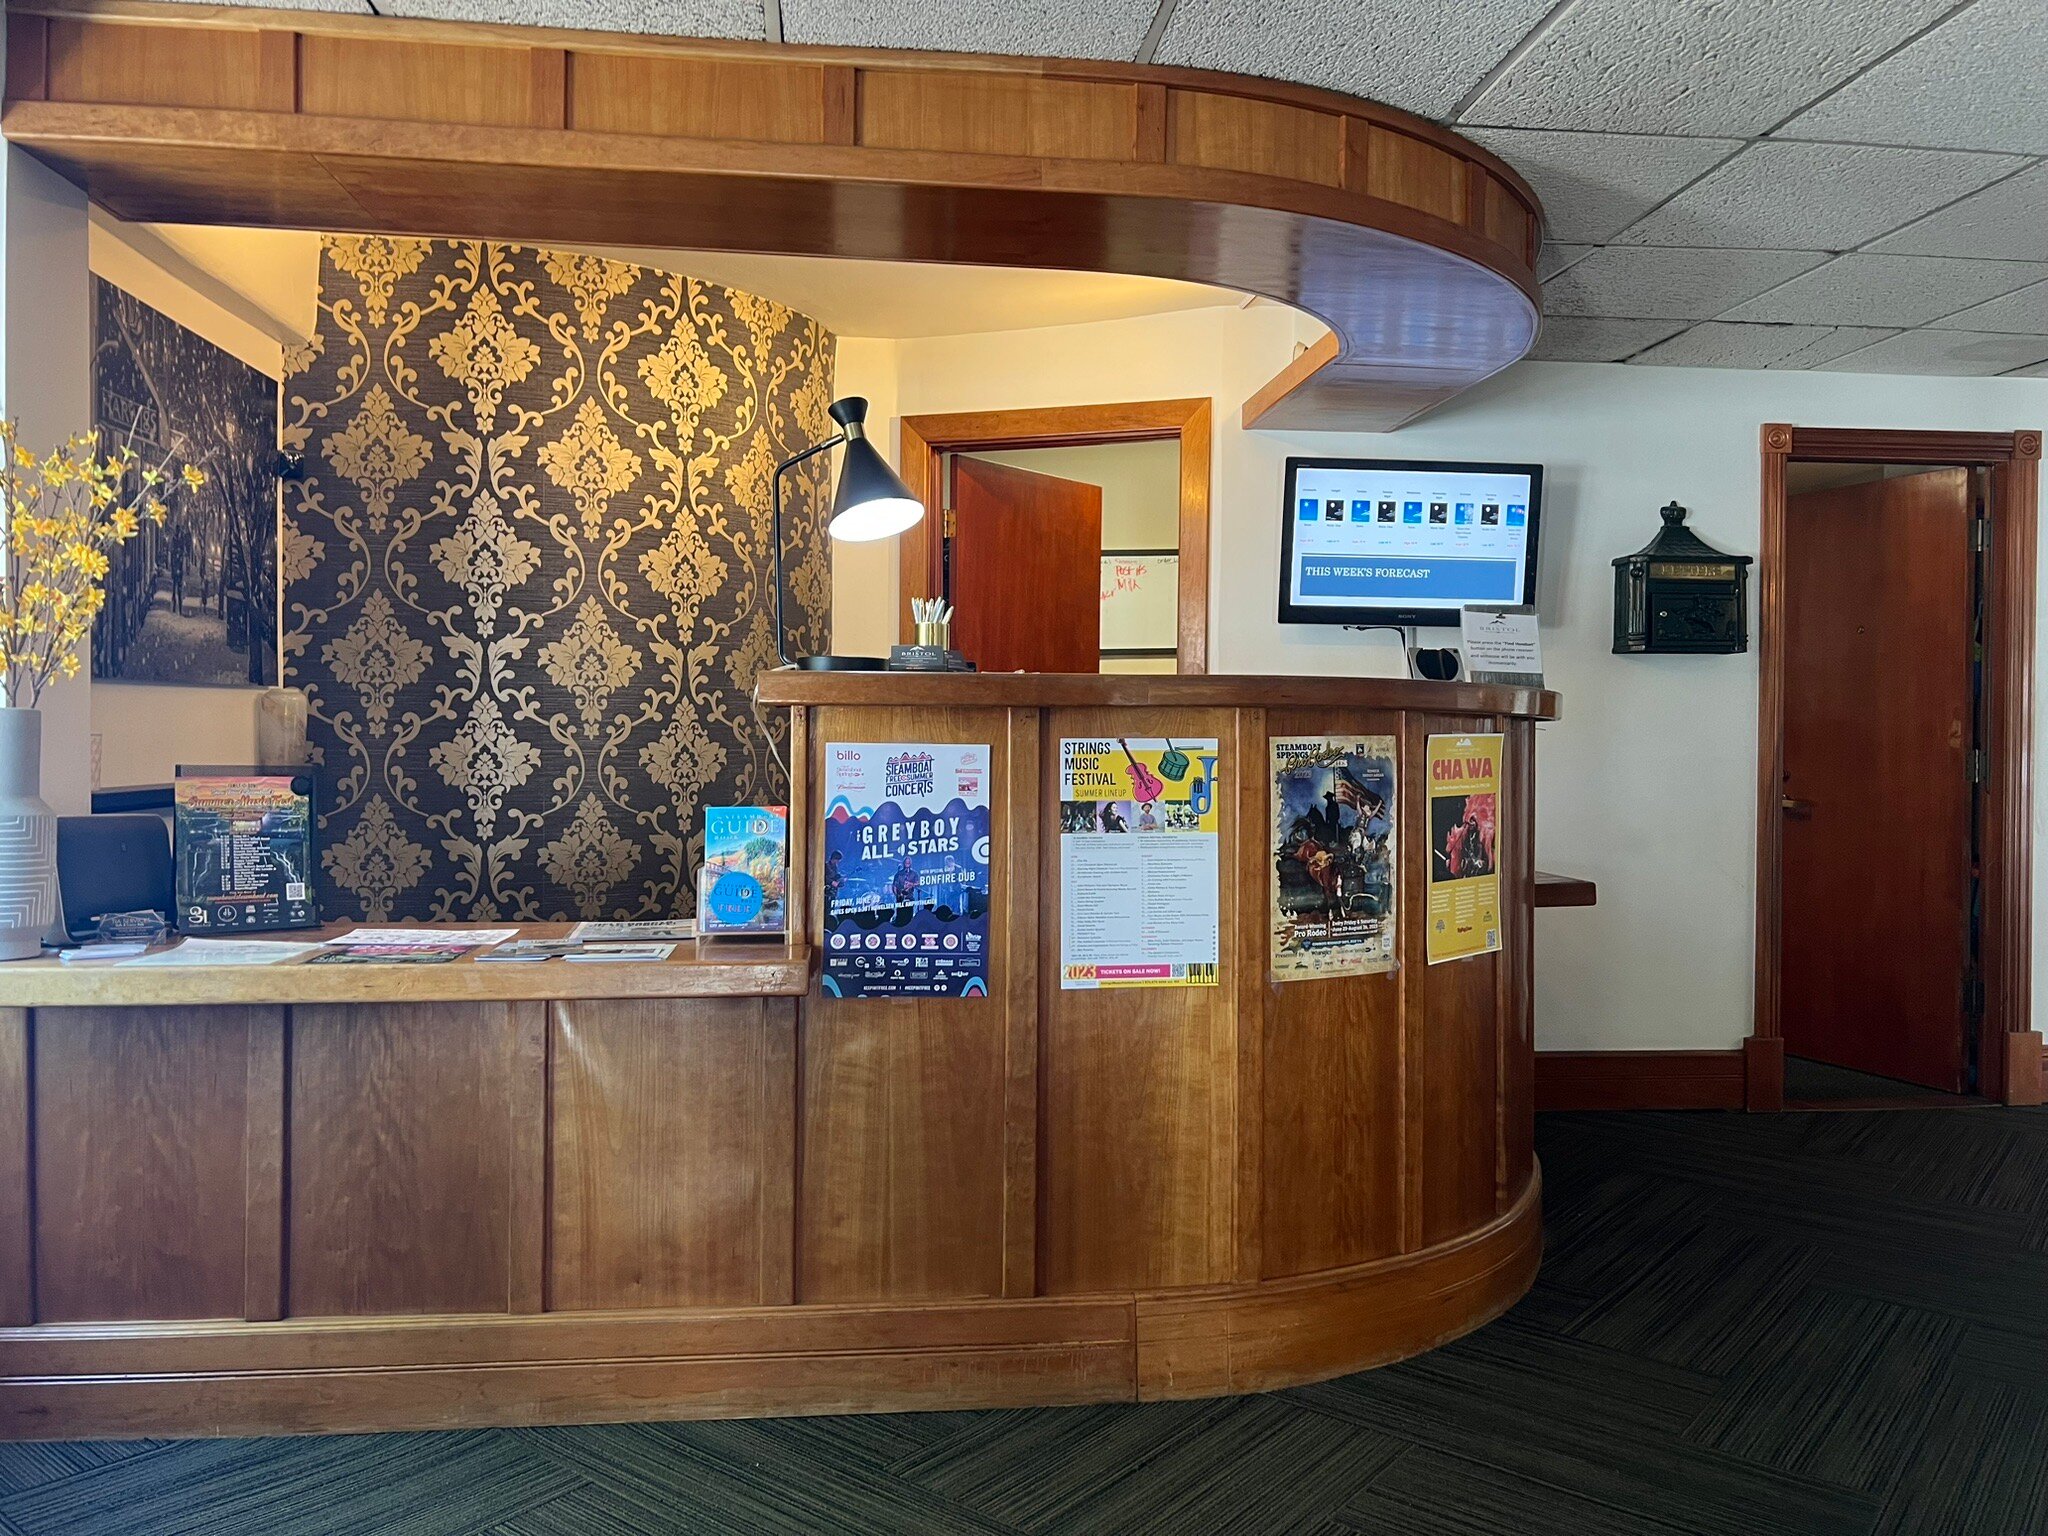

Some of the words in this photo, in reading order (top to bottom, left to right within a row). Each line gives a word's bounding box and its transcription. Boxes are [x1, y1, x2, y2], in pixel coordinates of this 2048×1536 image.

[1305, 567, 1331, 576] THIS
[1333, 567, 1373, 577] WEEK'S
[1375, 568, 1431, 578] FORECAST
[1064, 742, 1111, 755] STRINGS
[836, 750, 861, 761] billo
[885, 759, 933, 776] STEAMBOAT
[1064, 757, 1099, 770] MUSIC
[1432, 758, 1464, 780] CHA
[1465, 757, 1493, 779] WA
[885, 775, 901, 783] FREE
[907, 772, 934, 781] SUMMER
[1064, 773, 1116, 785] FESTIVAL
[885, 780, 933, 797] CONCERTS
[1075, 789, 1103, 797] SUMMER
[1104, 788, 1127, 797] LINEUP
[188, 795, 234, 808] Summer
[237, 794, 268, 807] Music
[270, 794, 295, 806] Fest
[710, 819, 780, 835] GUIDE
[862, 817, 960, 844] GREYBOY
[861, 843, 894, 861] ALL
[907, 836, 960, 856] STARS
[919, 874, 956, 886] BONFIRE
[958, 871, 976, 882] DUB
[830, 897, 855, 908] FRIDAY,
[1294, 930, 1306, 938] Pro
[1307, 929, 1327, 937] Rodeo
[1063, 963, 1097, 980] 2023
